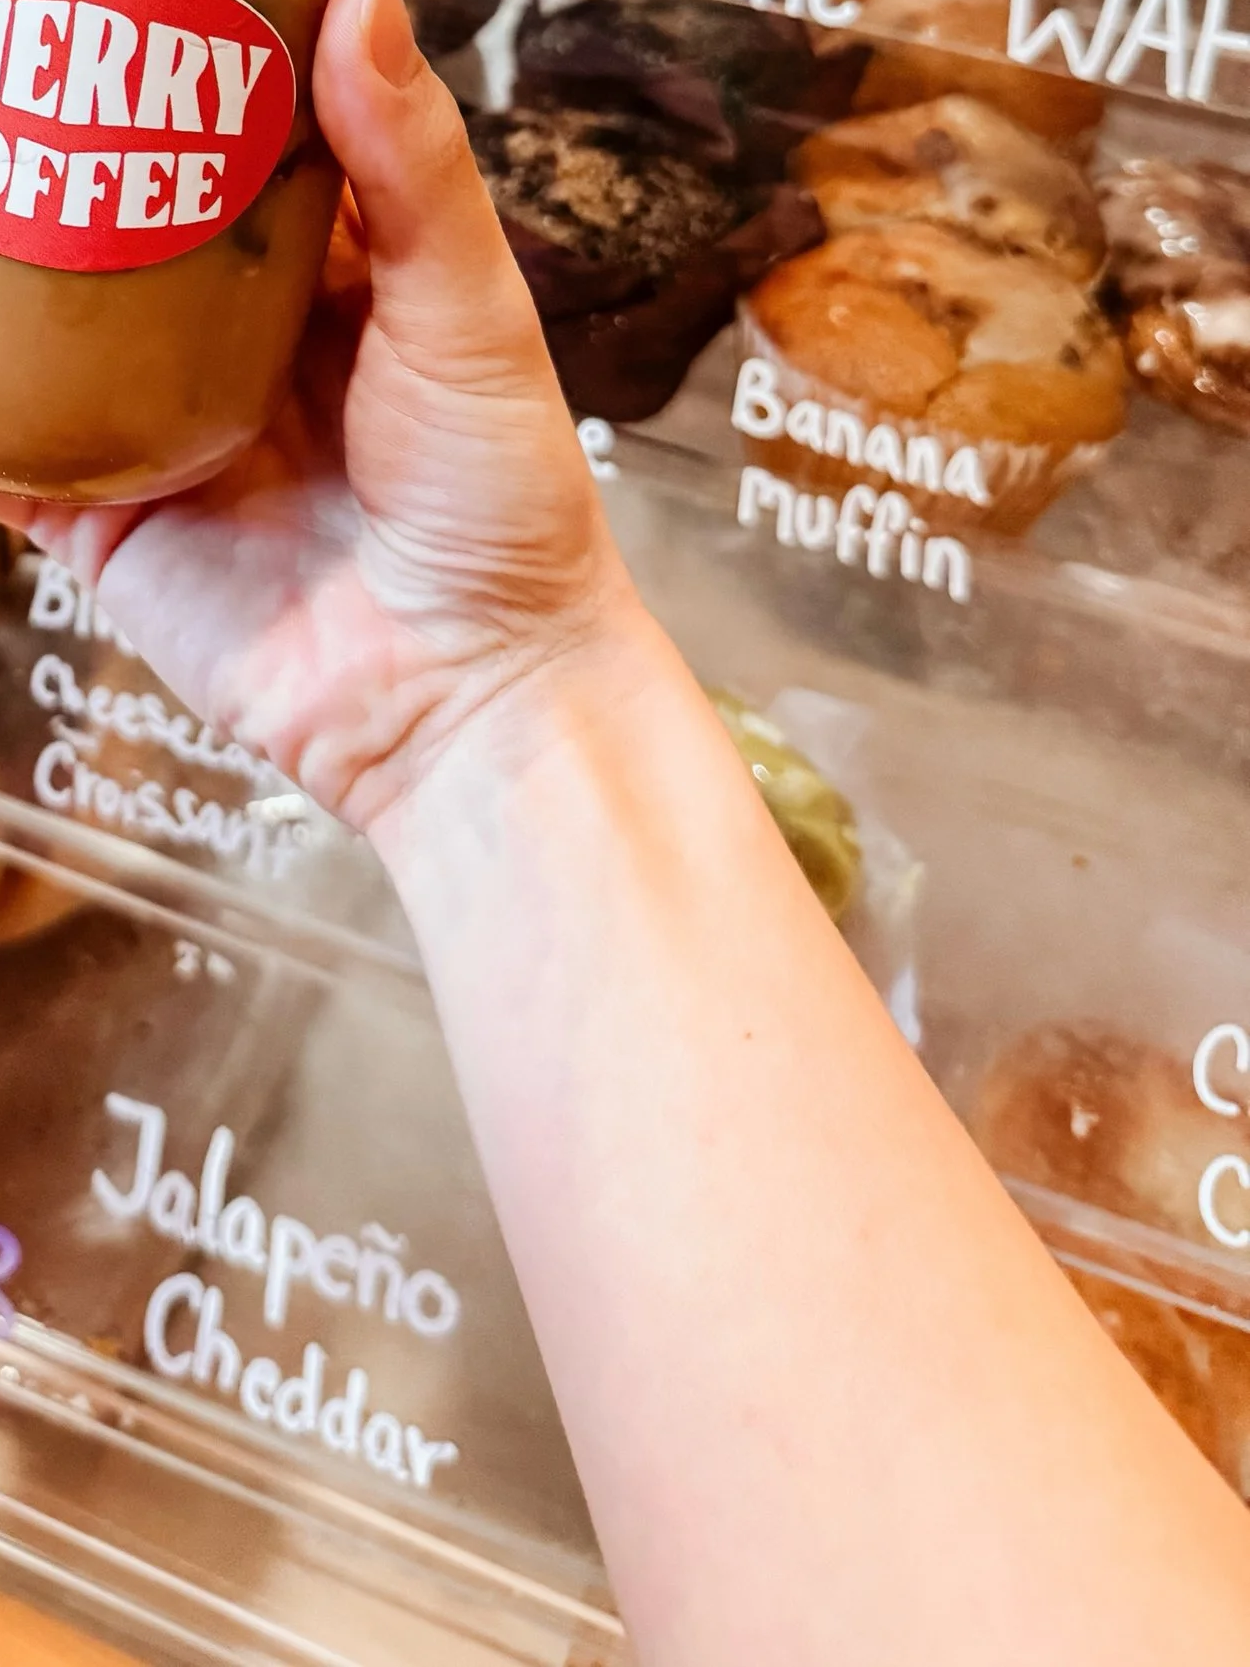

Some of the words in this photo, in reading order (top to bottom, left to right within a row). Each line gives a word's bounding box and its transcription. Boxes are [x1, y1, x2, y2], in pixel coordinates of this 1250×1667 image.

[730, 357, 990, 506] Banana
[90, 1091, 461, 1338] Jalapeño
[142, 1270, 459, 1490] Cheddar
